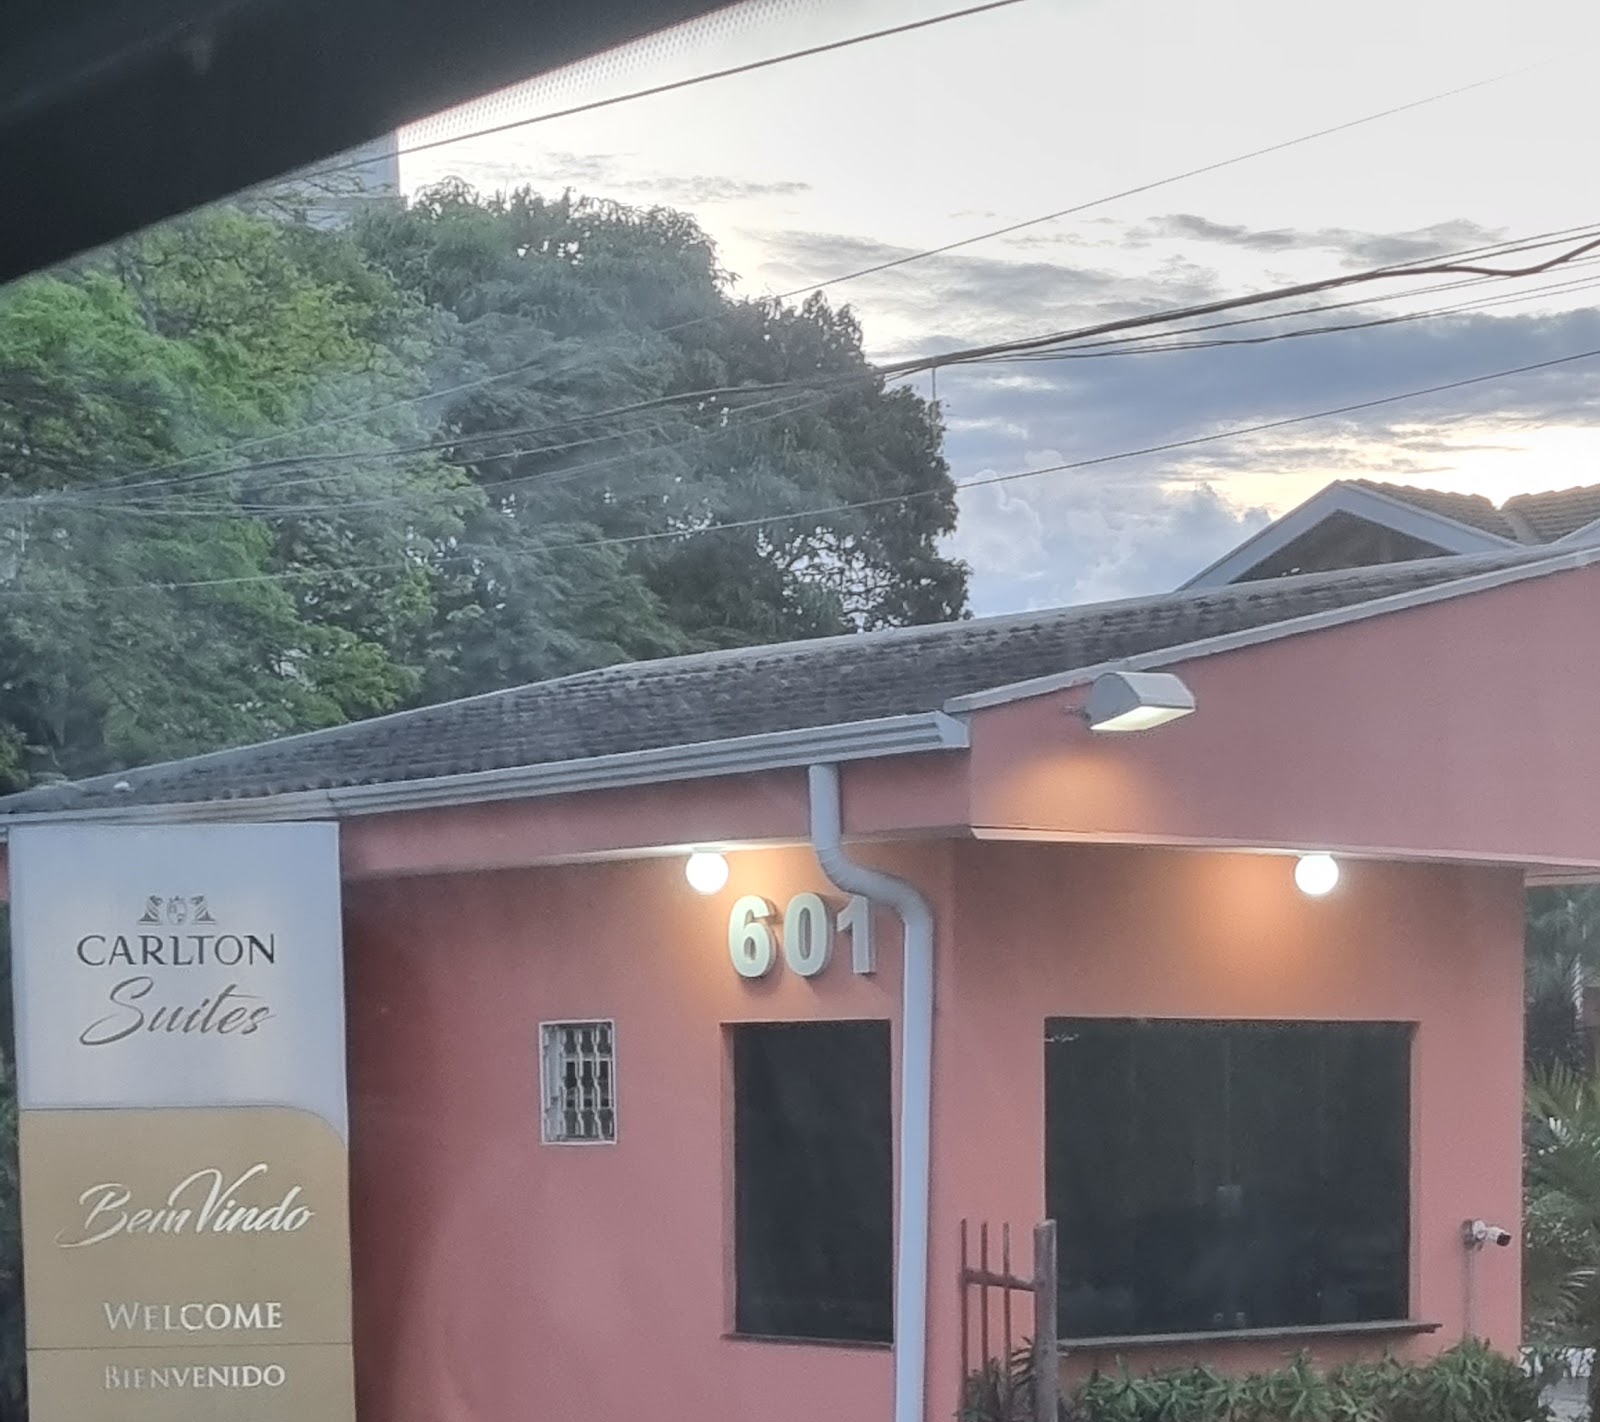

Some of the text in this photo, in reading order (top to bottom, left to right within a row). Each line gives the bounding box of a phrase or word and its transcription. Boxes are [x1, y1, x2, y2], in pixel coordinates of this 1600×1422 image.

[77, 933, 276, 966] CARLTON
[728, 892, 876, 978] 601
[79, 976, 277, 1046] Suites
[103, 1302, 283, 1331] WELCOME
[104, 1364, 286, 1390] BIENVENIDO
